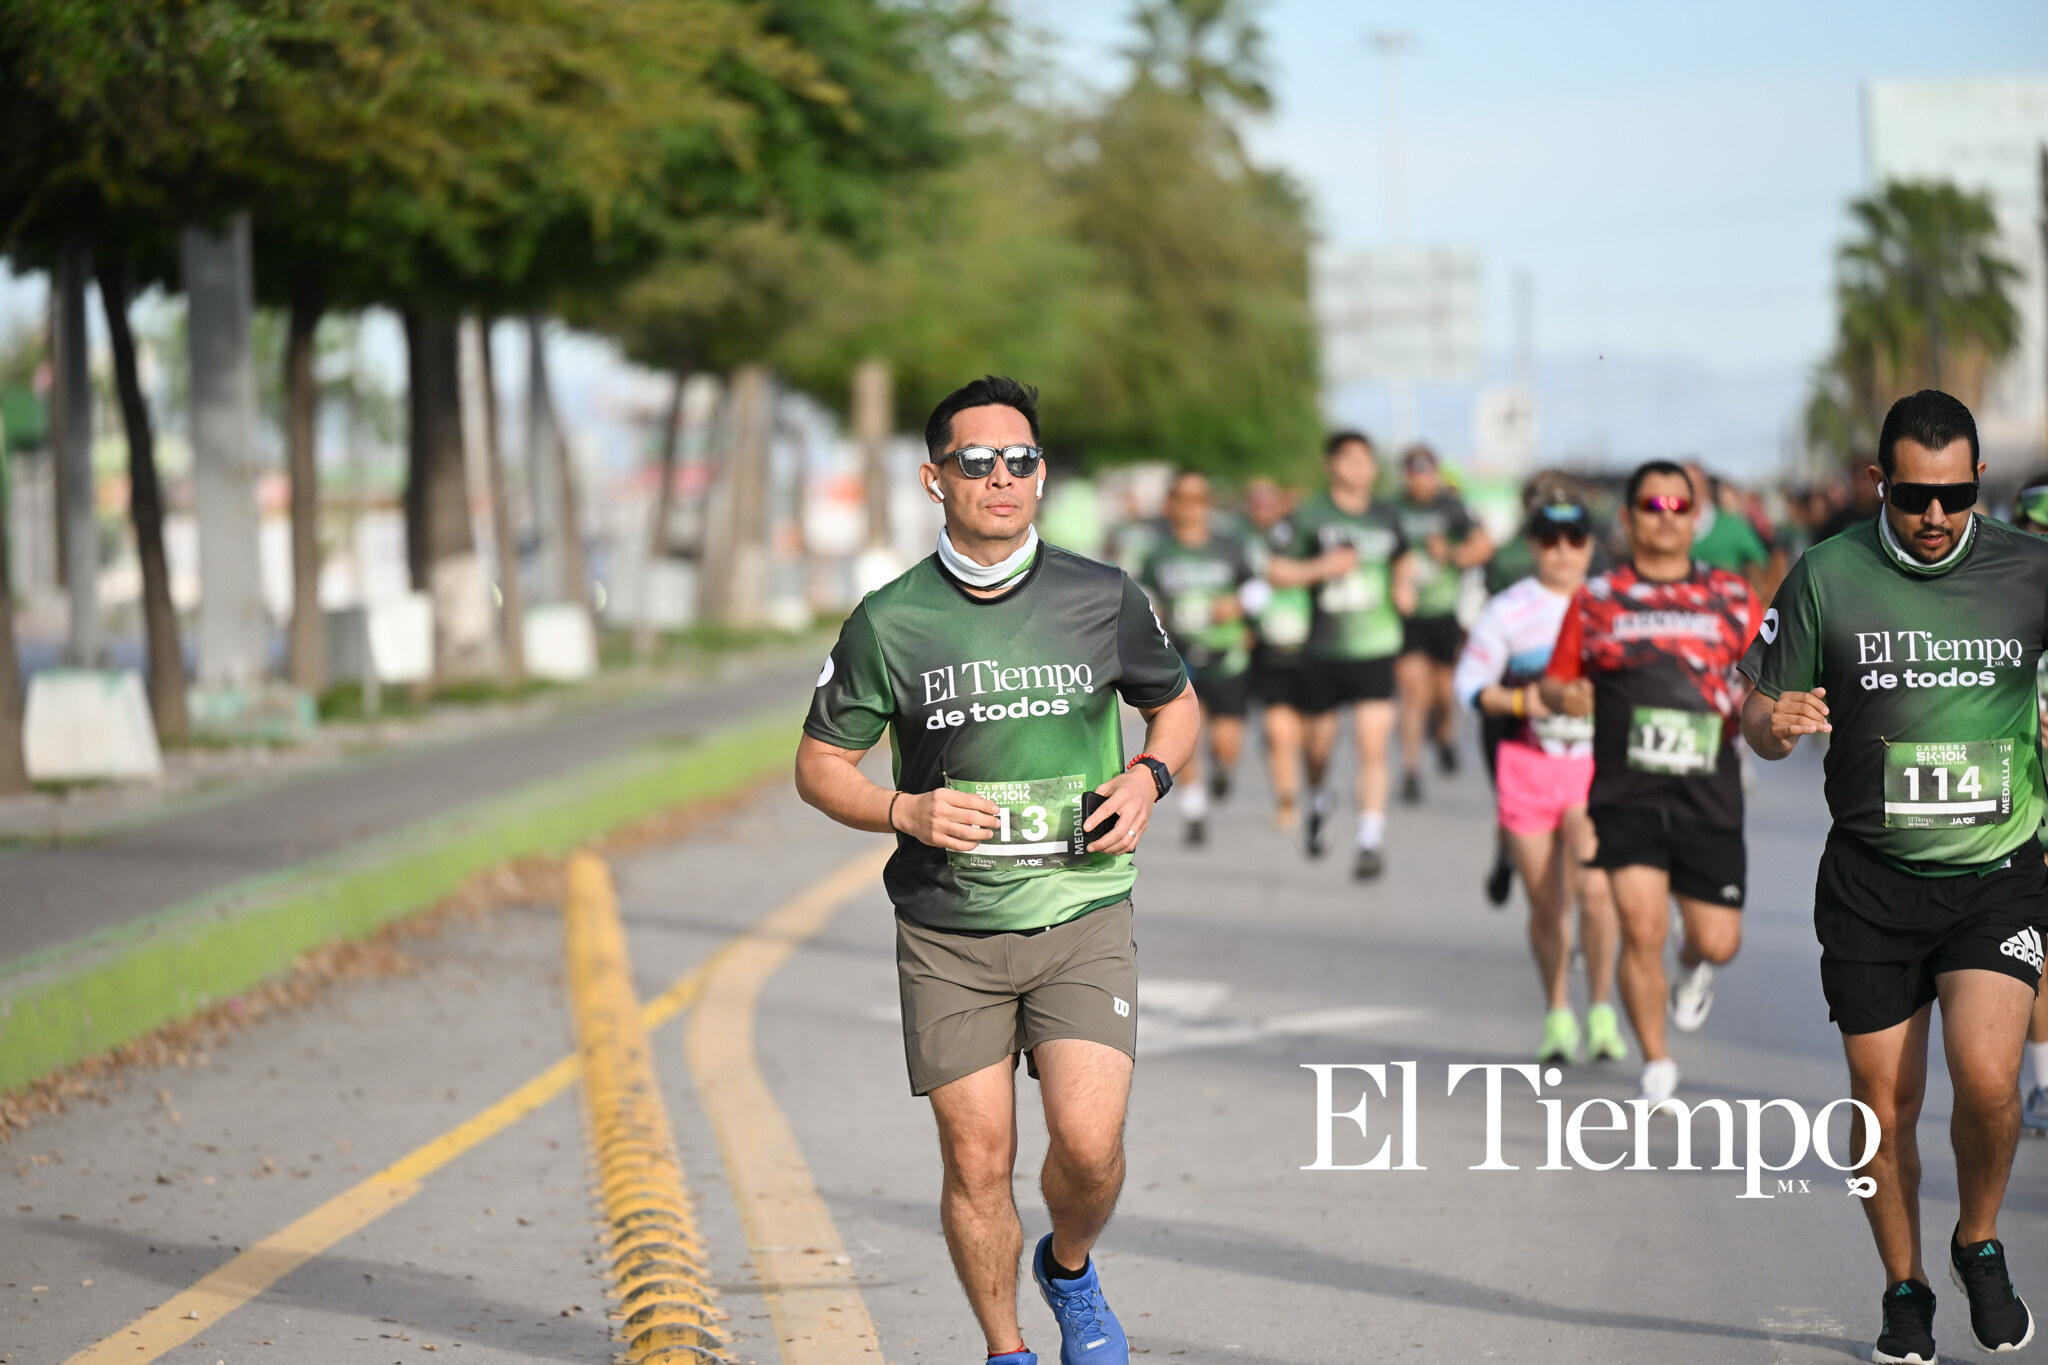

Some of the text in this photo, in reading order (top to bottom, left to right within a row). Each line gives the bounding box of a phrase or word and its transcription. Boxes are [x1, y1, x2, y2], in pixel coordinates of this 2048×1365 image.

[1855, 631, 2023, 668] El Tiempo
[920, 660, 1093, 706] El Tiempo
[1860, 667, 1996, 691] de todos
[926, 696, 1070, 730] de todos
[1915, 744, 1967, 752] CARRERA
[1999, 744, 2012, 753] 114
[975, 783, 1031, 791] CARRERA
[1068, 781, 1084, 790] 113
[1903, 765, 1983, 801] 114
[2001, 757, 2010, 814] MEDALLA
[1071, 794, 1085, 856] MEDALLA
[2000, 941, 2044, 975] adida
